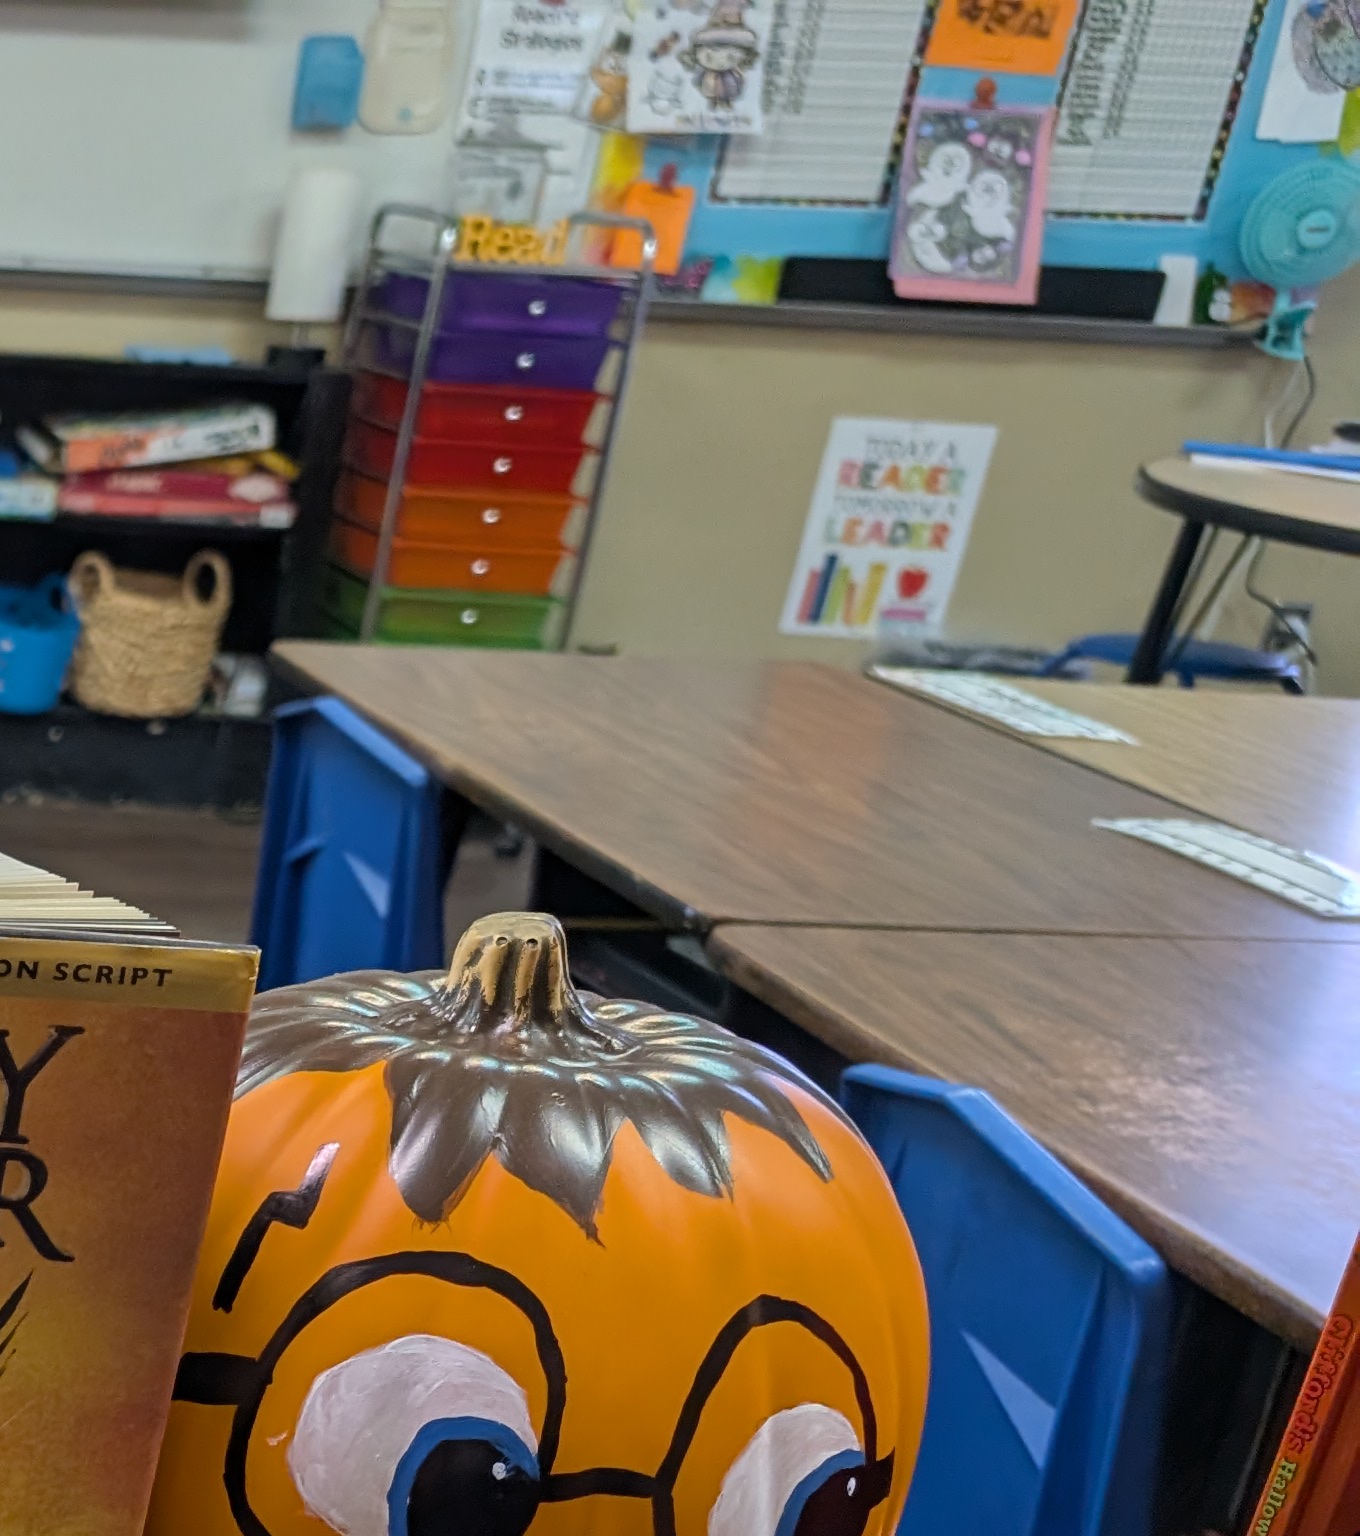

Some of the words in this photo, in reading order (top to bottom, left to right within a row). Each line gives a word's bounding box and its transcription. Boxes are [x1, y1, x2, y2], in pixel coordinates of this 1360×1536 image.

[455, 216, 570, 265] Read
[838, 459, 967, 496] READER
[823, 516, 951, 552] LEADER
[52, 961, 174, 988] SCRIPT
